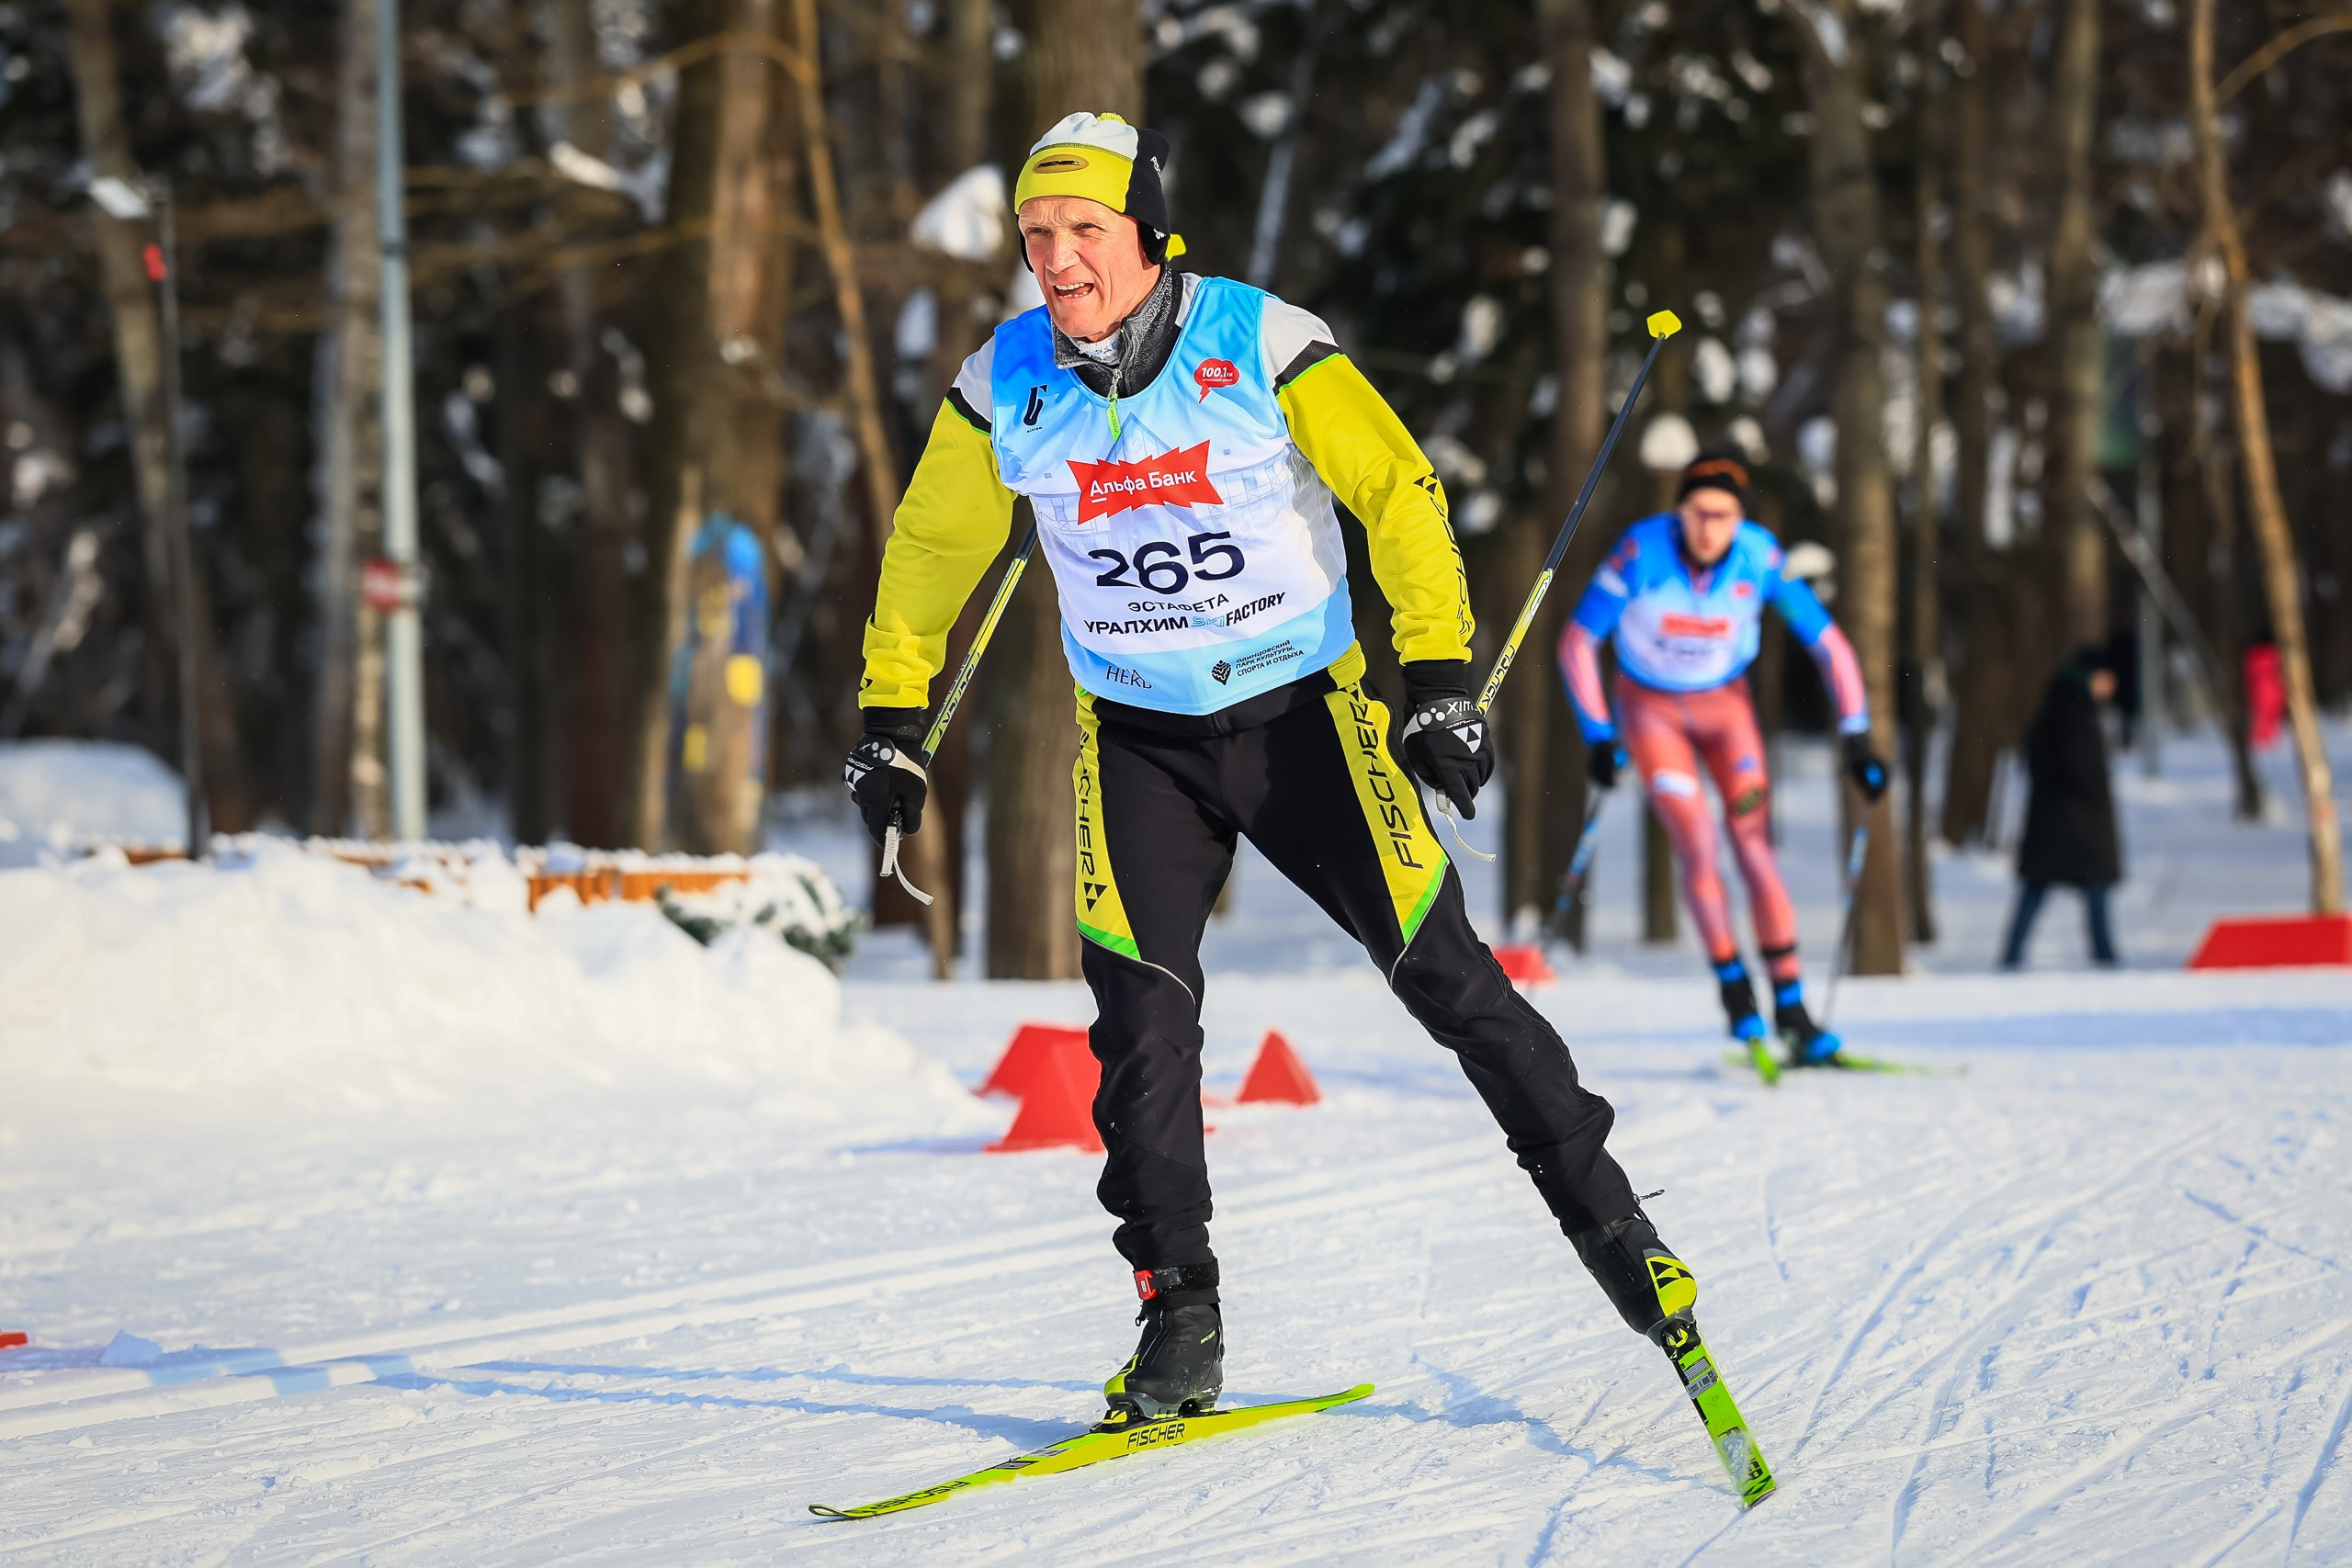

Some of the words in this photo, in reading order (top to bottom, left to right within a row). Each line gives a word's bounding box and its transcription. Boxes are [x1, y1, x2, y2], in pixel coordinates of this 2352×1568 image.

[1090, 475, 1148, 502] Альфа
[1148, 470, 1198, 489] Банк
[1087, 530, 1246, 595] 265
[1127, 592, 1230, 613] ЭСТАФЕТА
[1226, 592, 1286, 627] FACTORY
[1083, 615, 1190, 635] УРАЛХИМ
[1236, 660, 1255, 669] ПАРК
[1256, 645, 1295, 662] КУЛЬТУРЫ,
[1237, 662, 1265, 677] СПОРТА
[1272, 649, 1305, 664] ОТДЫХА
[1347, 700, 1425, 870] FISCHER
[1126, 1422, 1186, 1450] FISCHER
